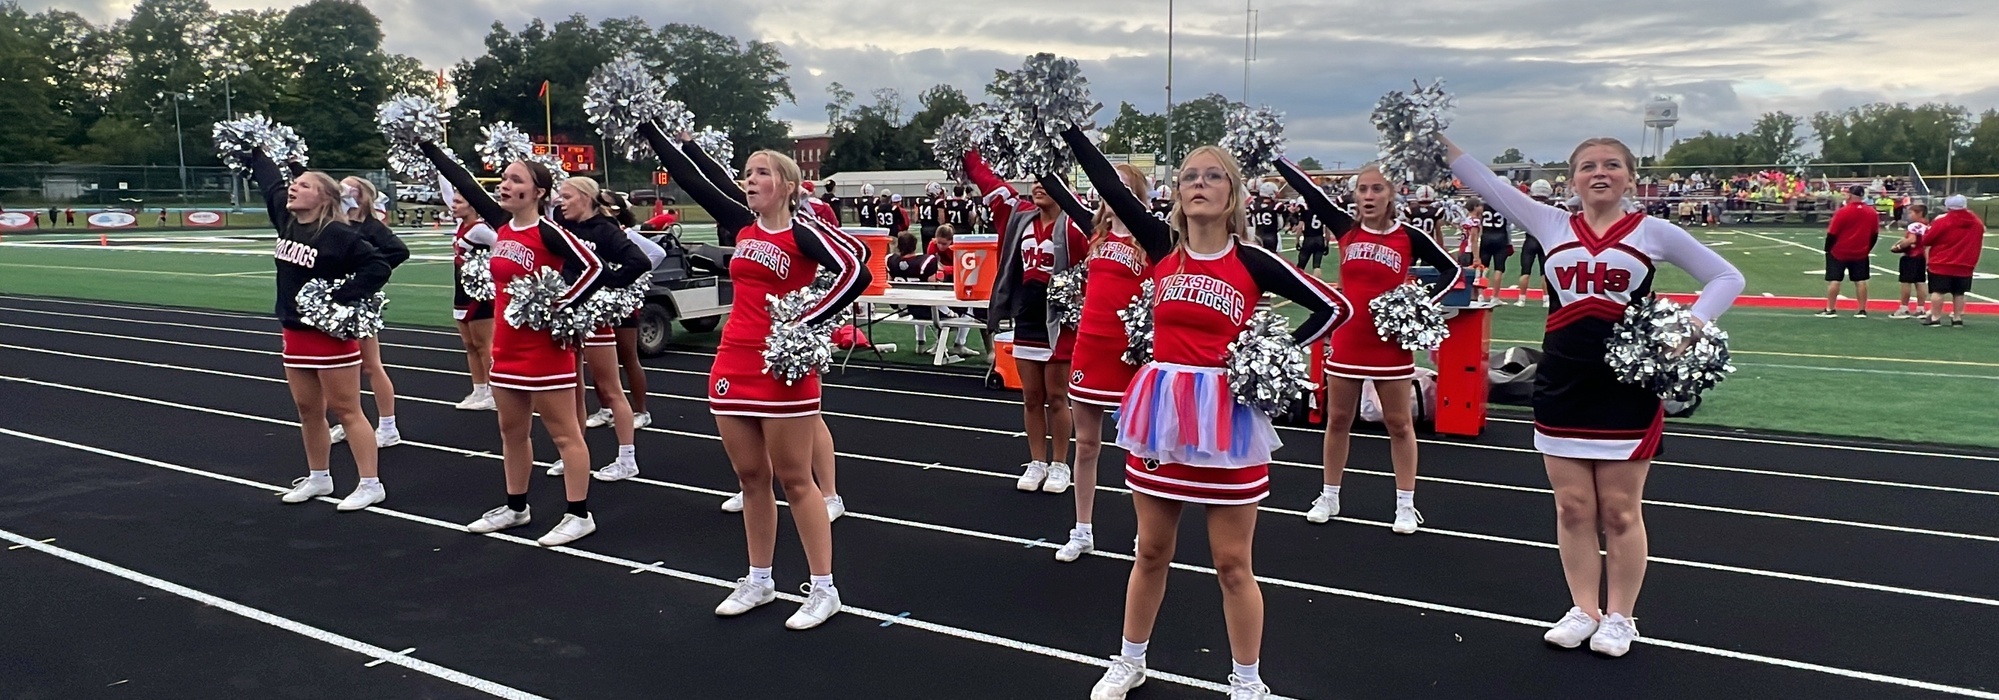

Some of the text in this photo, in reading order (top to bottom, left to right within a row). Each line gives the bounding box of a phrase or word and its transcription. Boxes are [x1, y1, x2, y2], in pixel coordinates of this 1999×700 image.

[658, 172, 667, 184] 18
[861, 208, 869, 219] 4
[877, 212, 893, 225] 33
[919, 205, 932, 219] 14
[949, 210, 961, 224] 71
[1256, 212, 1272, 225] 16
[1481, 211, 1504, 228] 23
[1311, 214, 1322, 229] 6
[1412, 217, 1434, 234] 20
[274, 237, 318, 269] ULLDOGS
[961, 252, 976, 270] G
[1153, 273, 1245, 327] VICKSBURG
[1162, 286, 1232, 317] BULLDOGS
